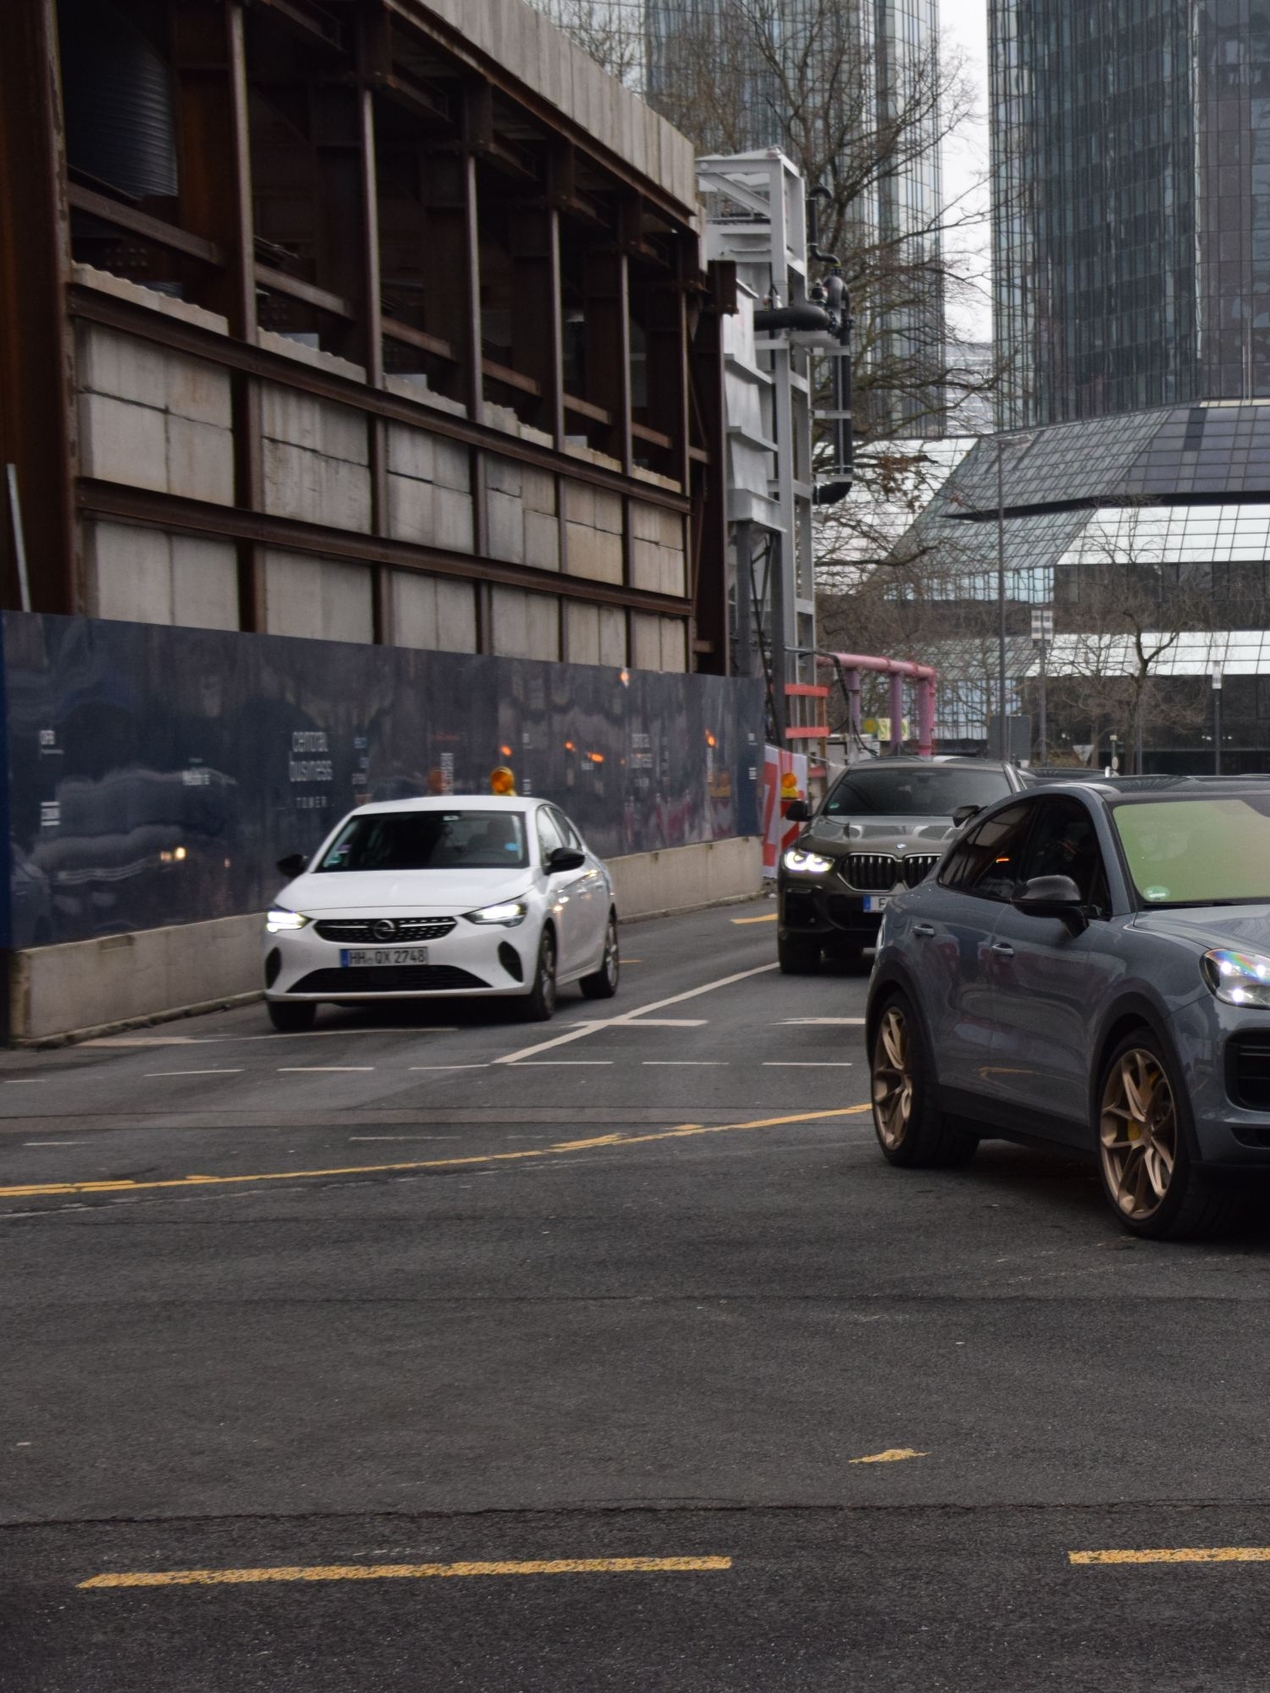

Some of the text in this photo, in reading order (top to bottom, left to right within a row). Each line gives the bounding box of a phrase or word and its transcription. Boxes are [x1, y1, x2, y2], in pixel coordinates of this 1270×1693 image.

[878, 897, 887, 909] F
[349, 949, 425, 964] HH QX 2748
